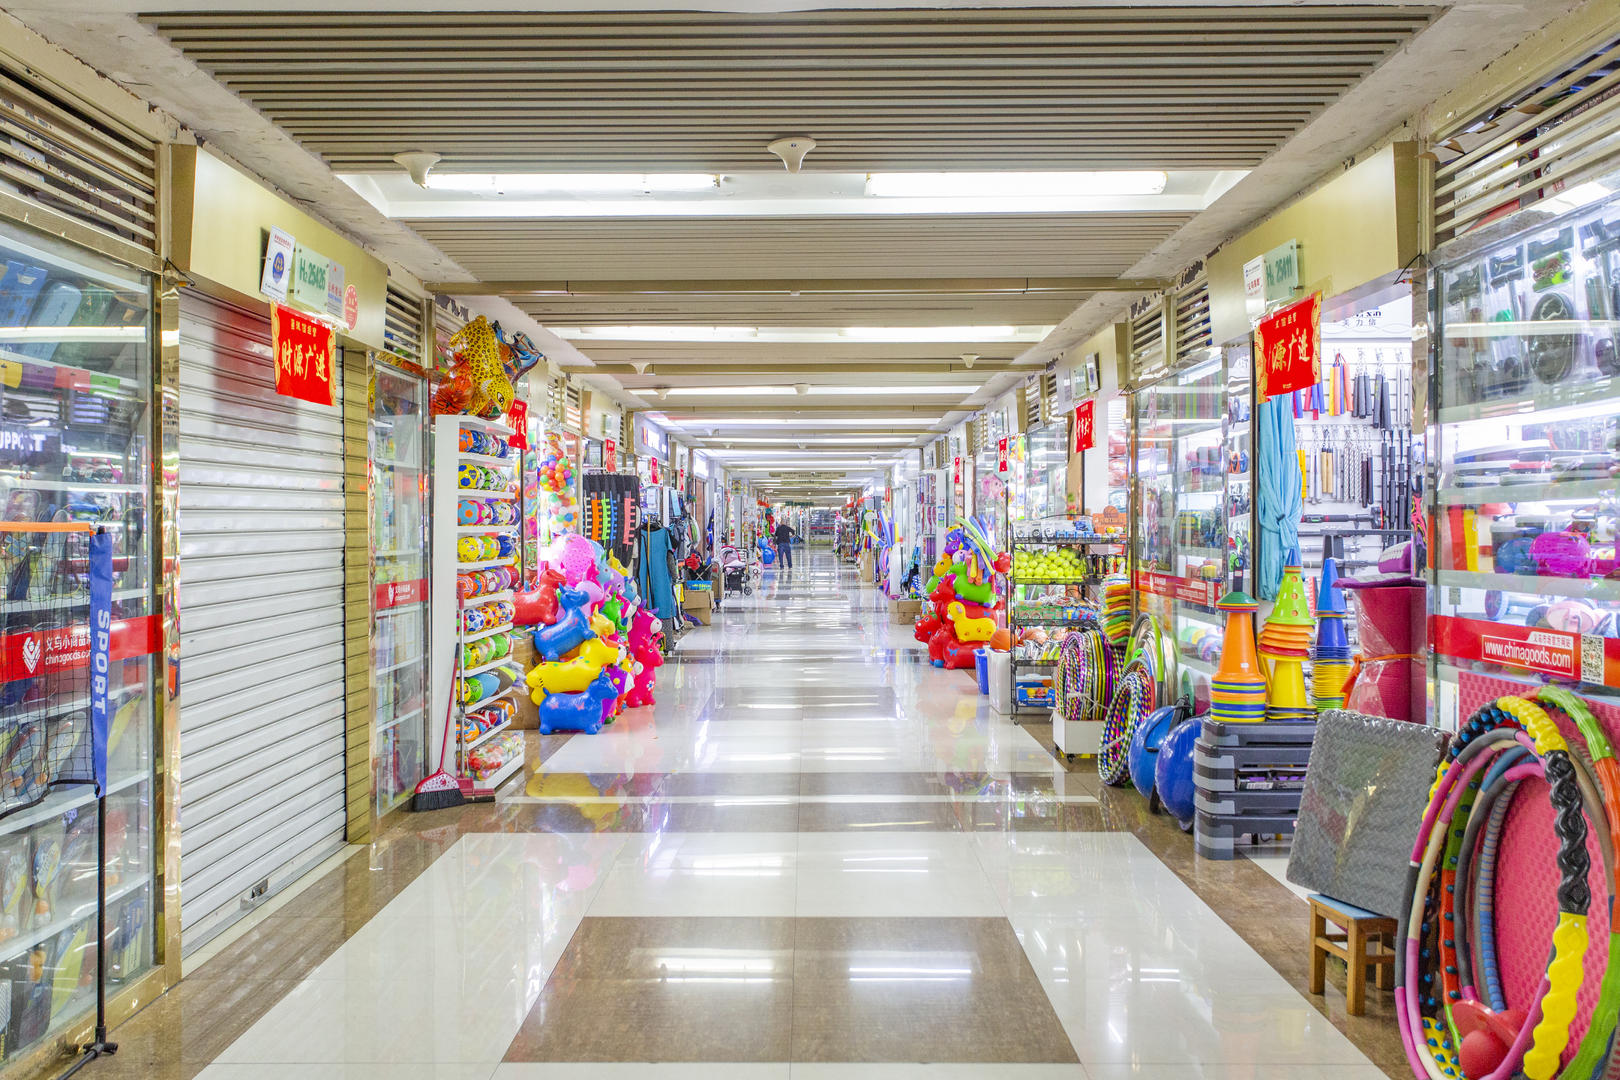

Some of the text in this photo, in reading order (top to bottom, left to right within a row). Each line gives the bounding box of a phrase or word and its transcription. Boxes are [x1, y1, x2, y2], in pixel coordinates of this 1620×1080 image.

[281, 338, 328, 383] 财源广进
[1268, 327, 1310, 374] 源广进
[45, 649, 91, 665] chinagoods.co
[94, 609, 110, 715] SPORT
[1484, 641, 1572, 669] www.chinagoods.com
